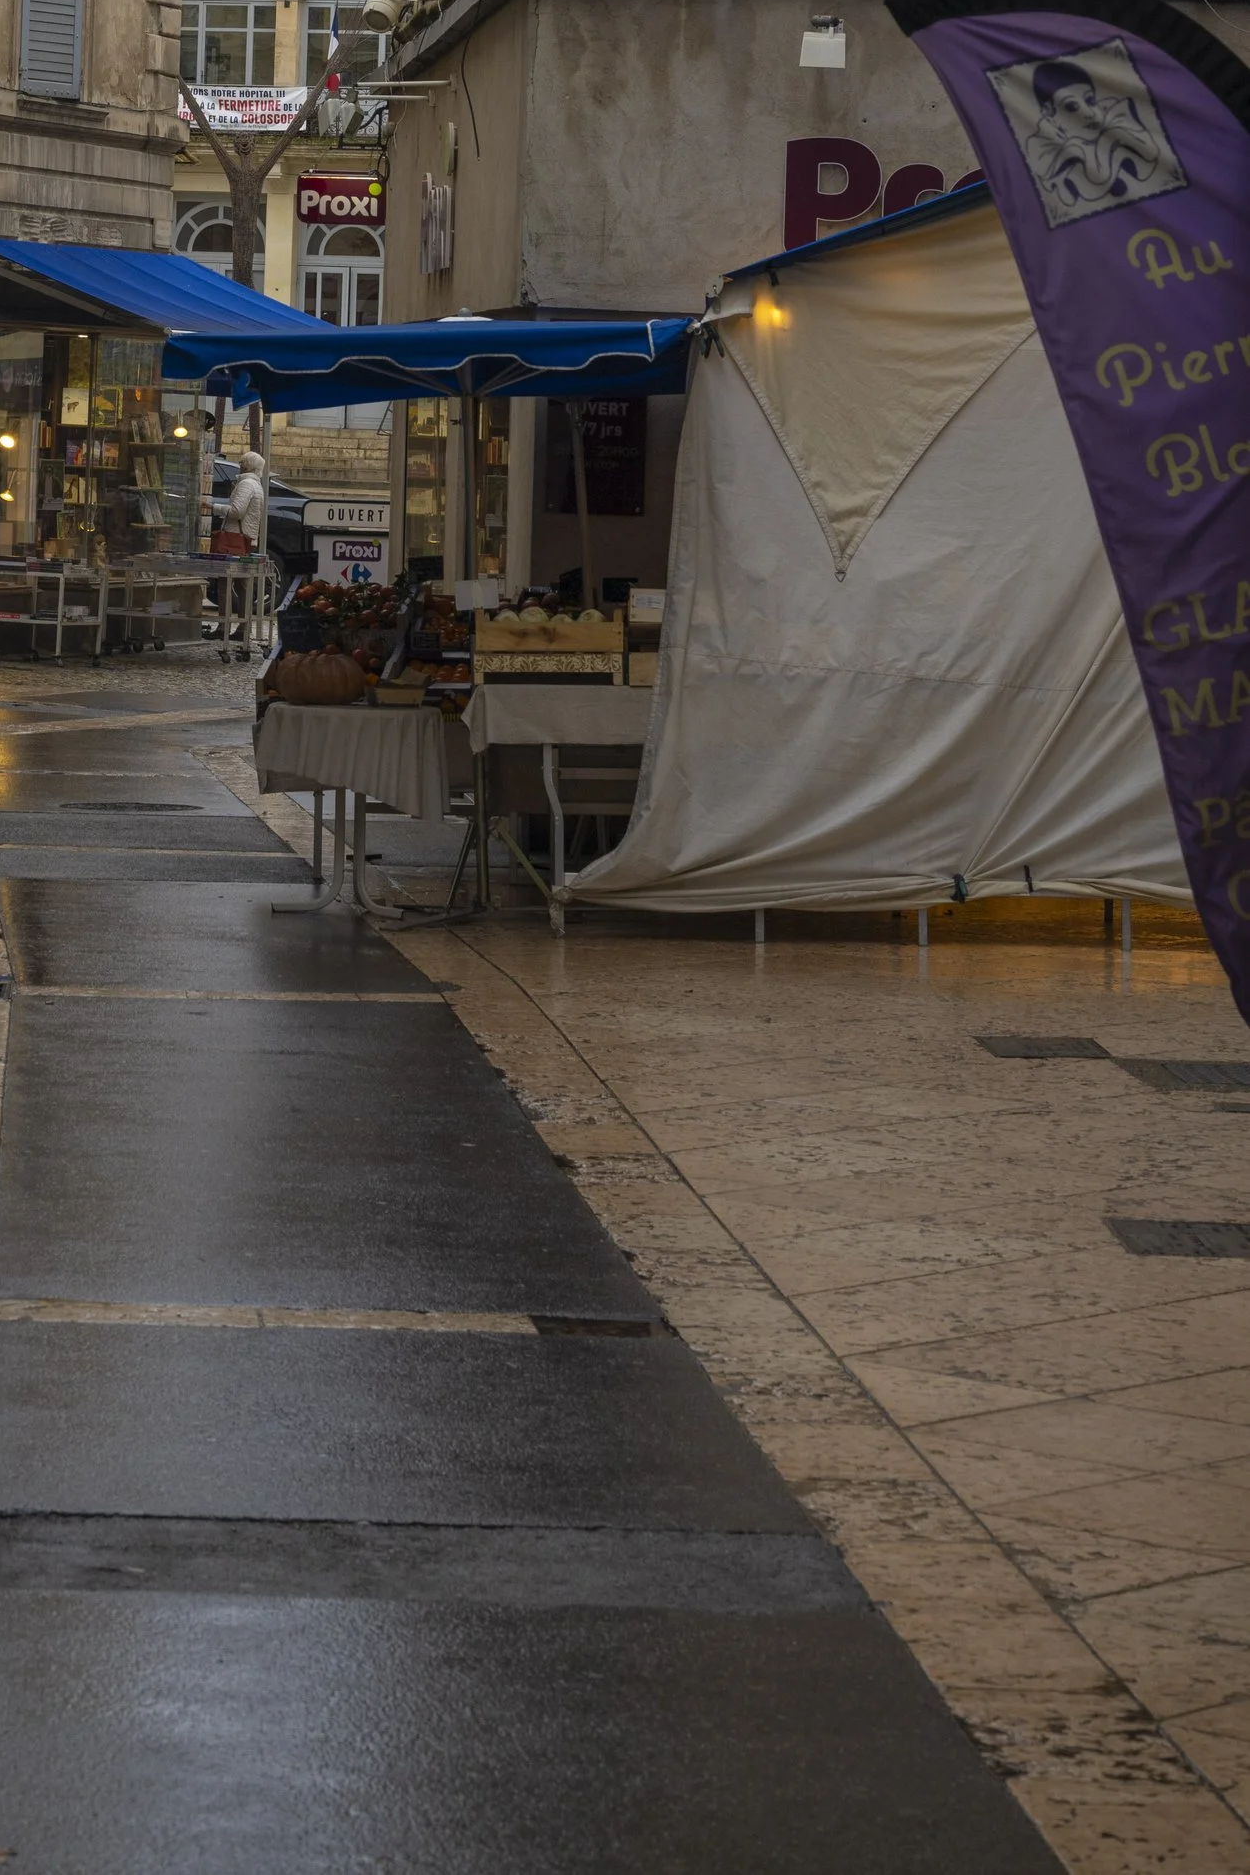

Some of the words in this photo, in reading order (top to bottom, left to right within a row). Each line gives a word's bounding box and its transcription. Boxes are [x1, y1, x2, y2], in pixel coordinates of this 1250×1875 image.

[211, 89, 237, 98] NOTRE
[218, 99, 281, 112] FERMETURE
[283, 103, 293, 111] DE
[218, 115, 228, 123] DE
[300, 182, 382, 217] Proxi
[1126, 226, 1233, 291] Au
[599, 422, 623, 439] jrs
[327, 508, 384, 522] OUVERT
[335, 539, 380, 558] Proxi
